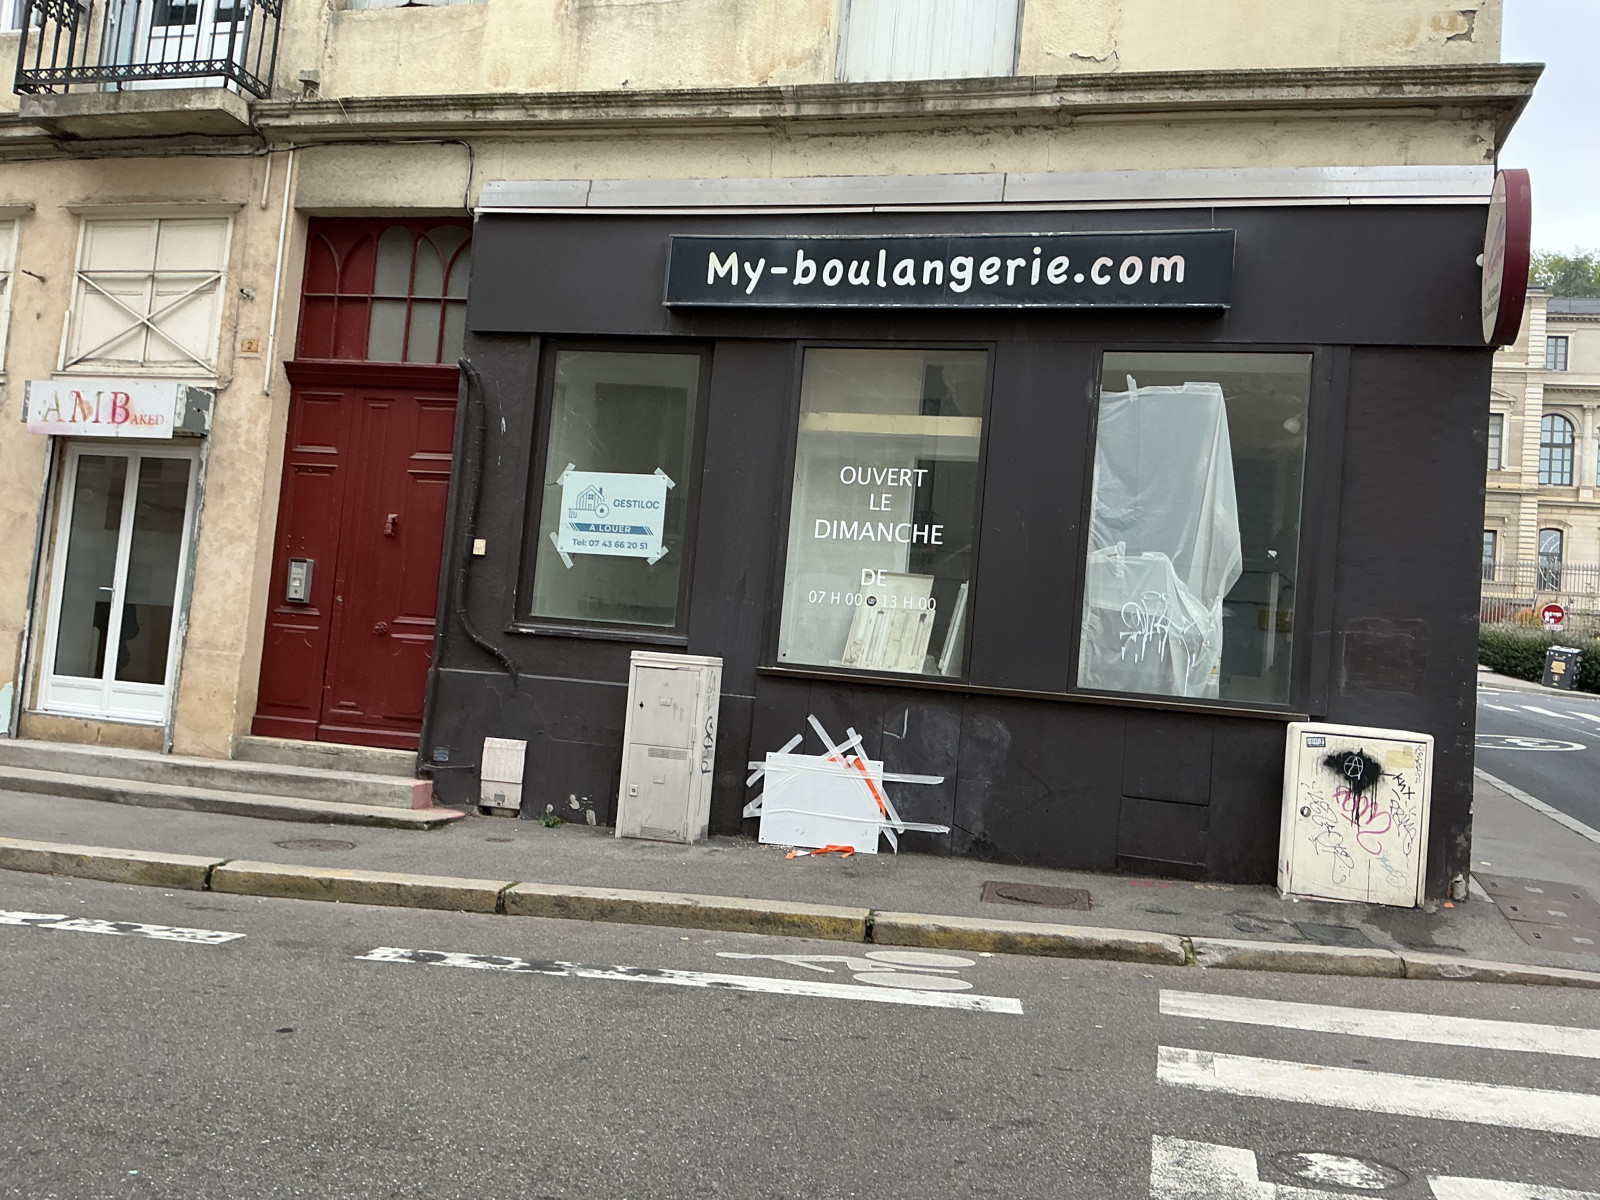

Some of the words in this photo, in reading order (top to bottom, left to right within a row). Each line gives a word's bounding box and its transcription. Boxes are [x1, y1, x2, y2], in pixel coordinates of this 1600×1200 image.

[705, 245, 1186, 295] My-boulangerie.com
[246, 341, 253, 350] 2
[840, 466, 928, 487] OUVERT
[613, 499, 660, 510] GESTILOC
[869, 493, 893, 512] LE
[599, 525, 632, 534] LOUER
[814, 519, 944, 546] DIMANCHE
[572, 538, 587, 546] Tel:
[602, 540, 612, 548] 43
[614, 541, 625, 549] 66
[627, 541, 638, 549] 20
[640, 542, 648, 550] 51
[860, 568, 888, 587] DE
[808, 590, 826, 604] 07
[830, 591, 841, 605] H
[845, 592, 863, 606] 00
[882, 595, 897, 609] 13
[903, 596, 913, 610] H
[918, 597, 936, 611] 00
